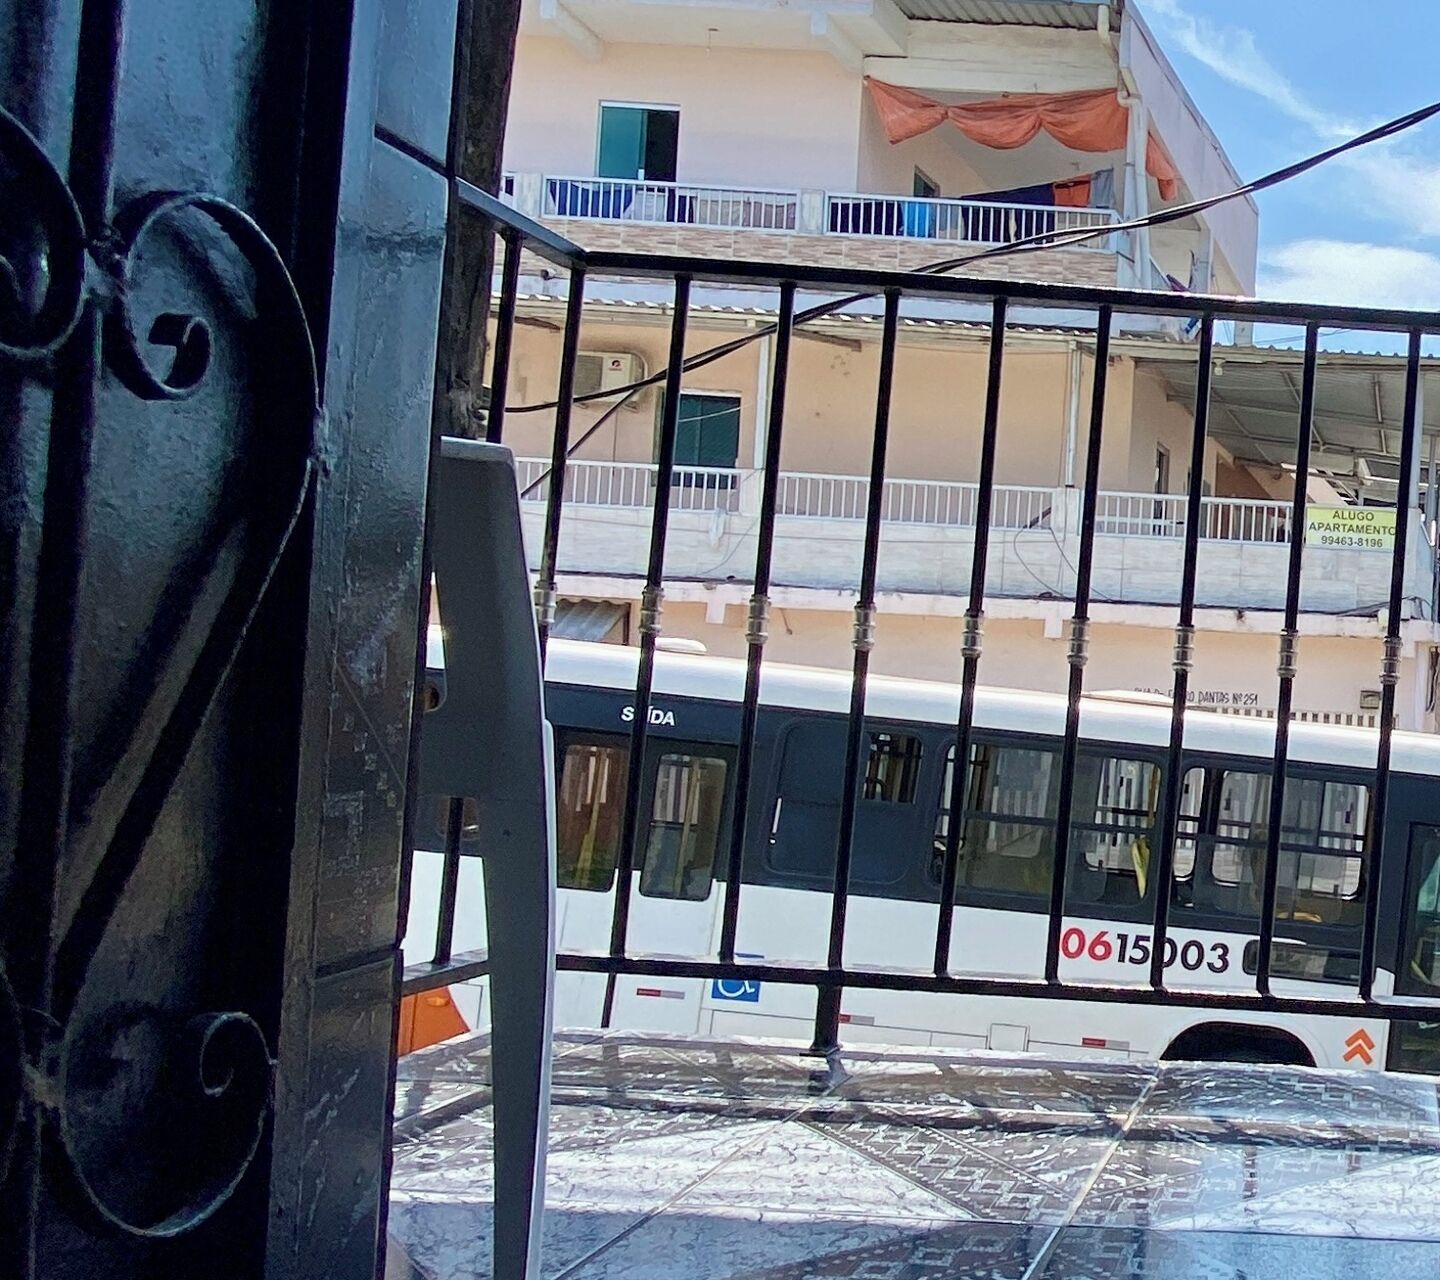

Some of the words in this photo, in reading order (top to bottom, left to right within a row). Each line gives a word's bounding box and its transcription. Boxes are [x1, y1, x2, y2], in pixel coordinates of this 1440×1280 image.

[1332, 510, 1375, 521] ALUGO
[1308, 522, 1397, 536] APARTAMENTO
[1320, 535, 1383, 548] 99463-8196
[620, 705, 675, 726] SÍDA
[1061, 927, 1230, 974] 0615003
